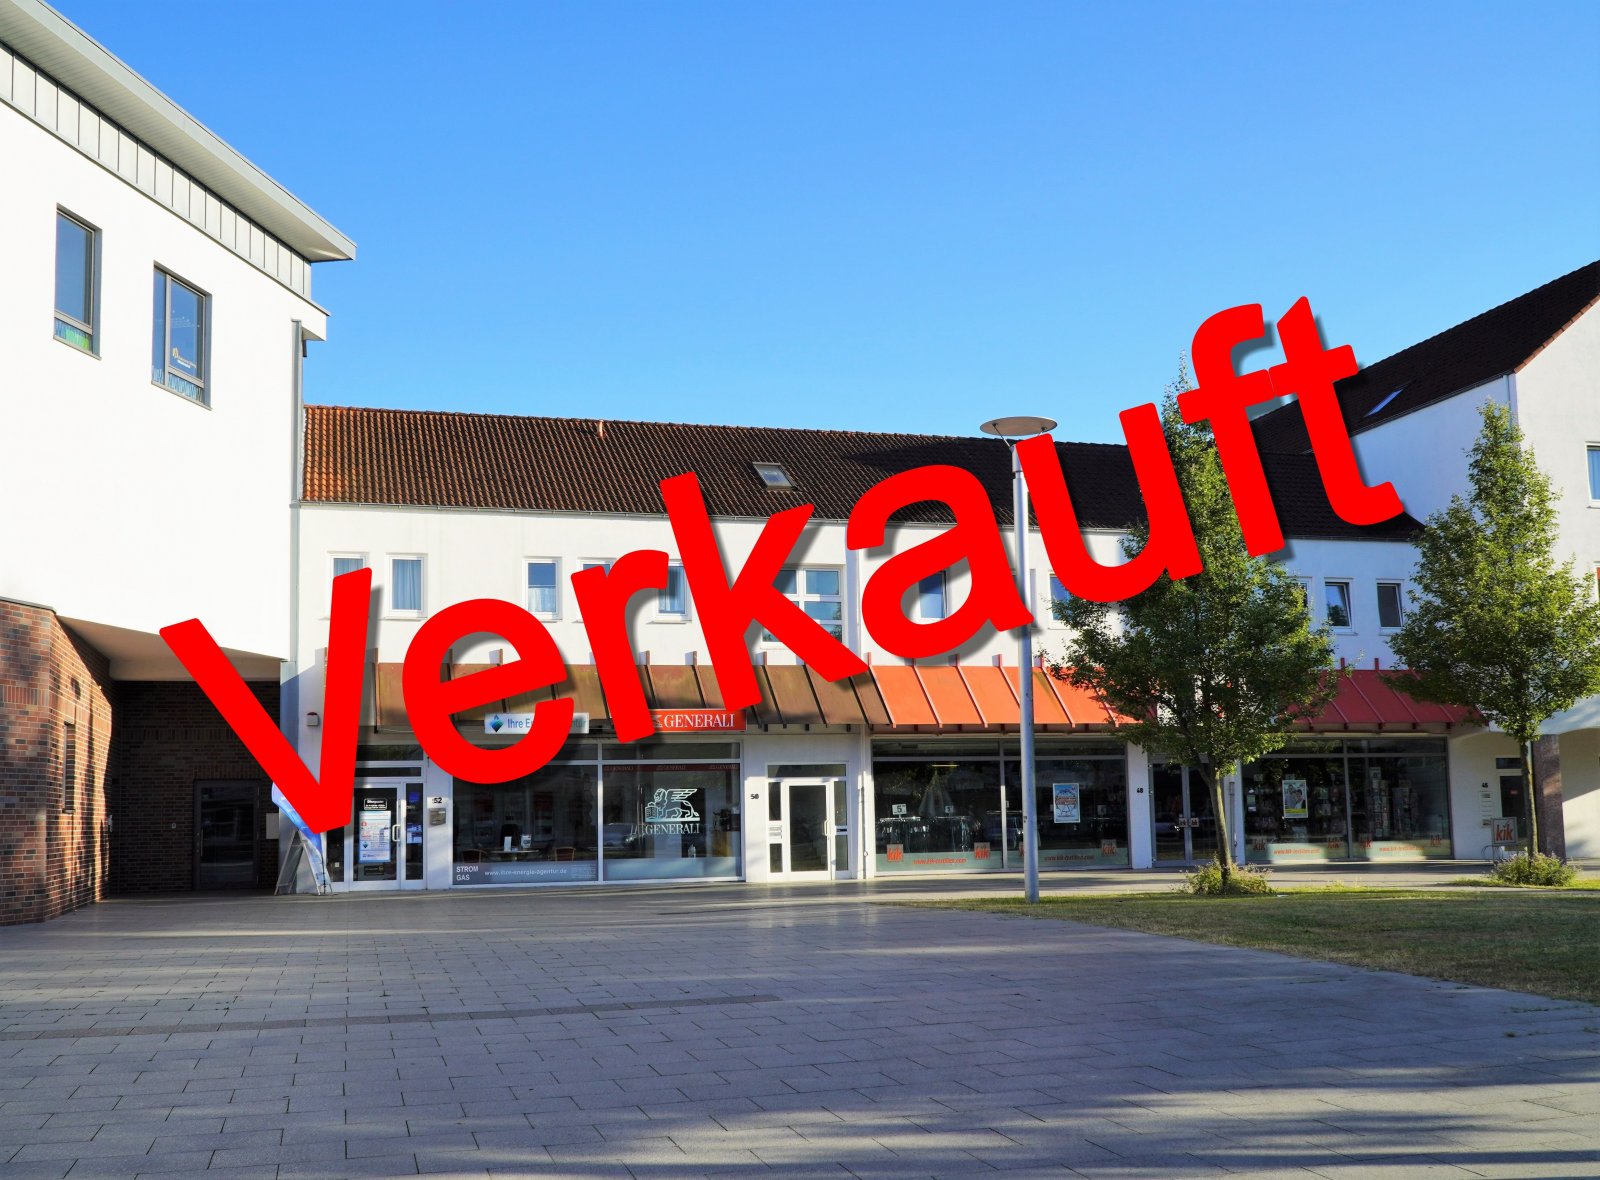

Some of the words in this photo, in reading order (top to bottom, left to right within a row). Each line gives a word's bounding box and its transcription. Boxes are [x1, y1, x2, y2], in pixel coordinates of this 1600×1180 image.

[507, 718, 524, 728] Ihre
[663, 713, 735, 728] GENERALI
[645, 823, 700, 835] GENERALI
[1495, 823, 1514, 841] kik
[456, 865, 479, 873] STROM
